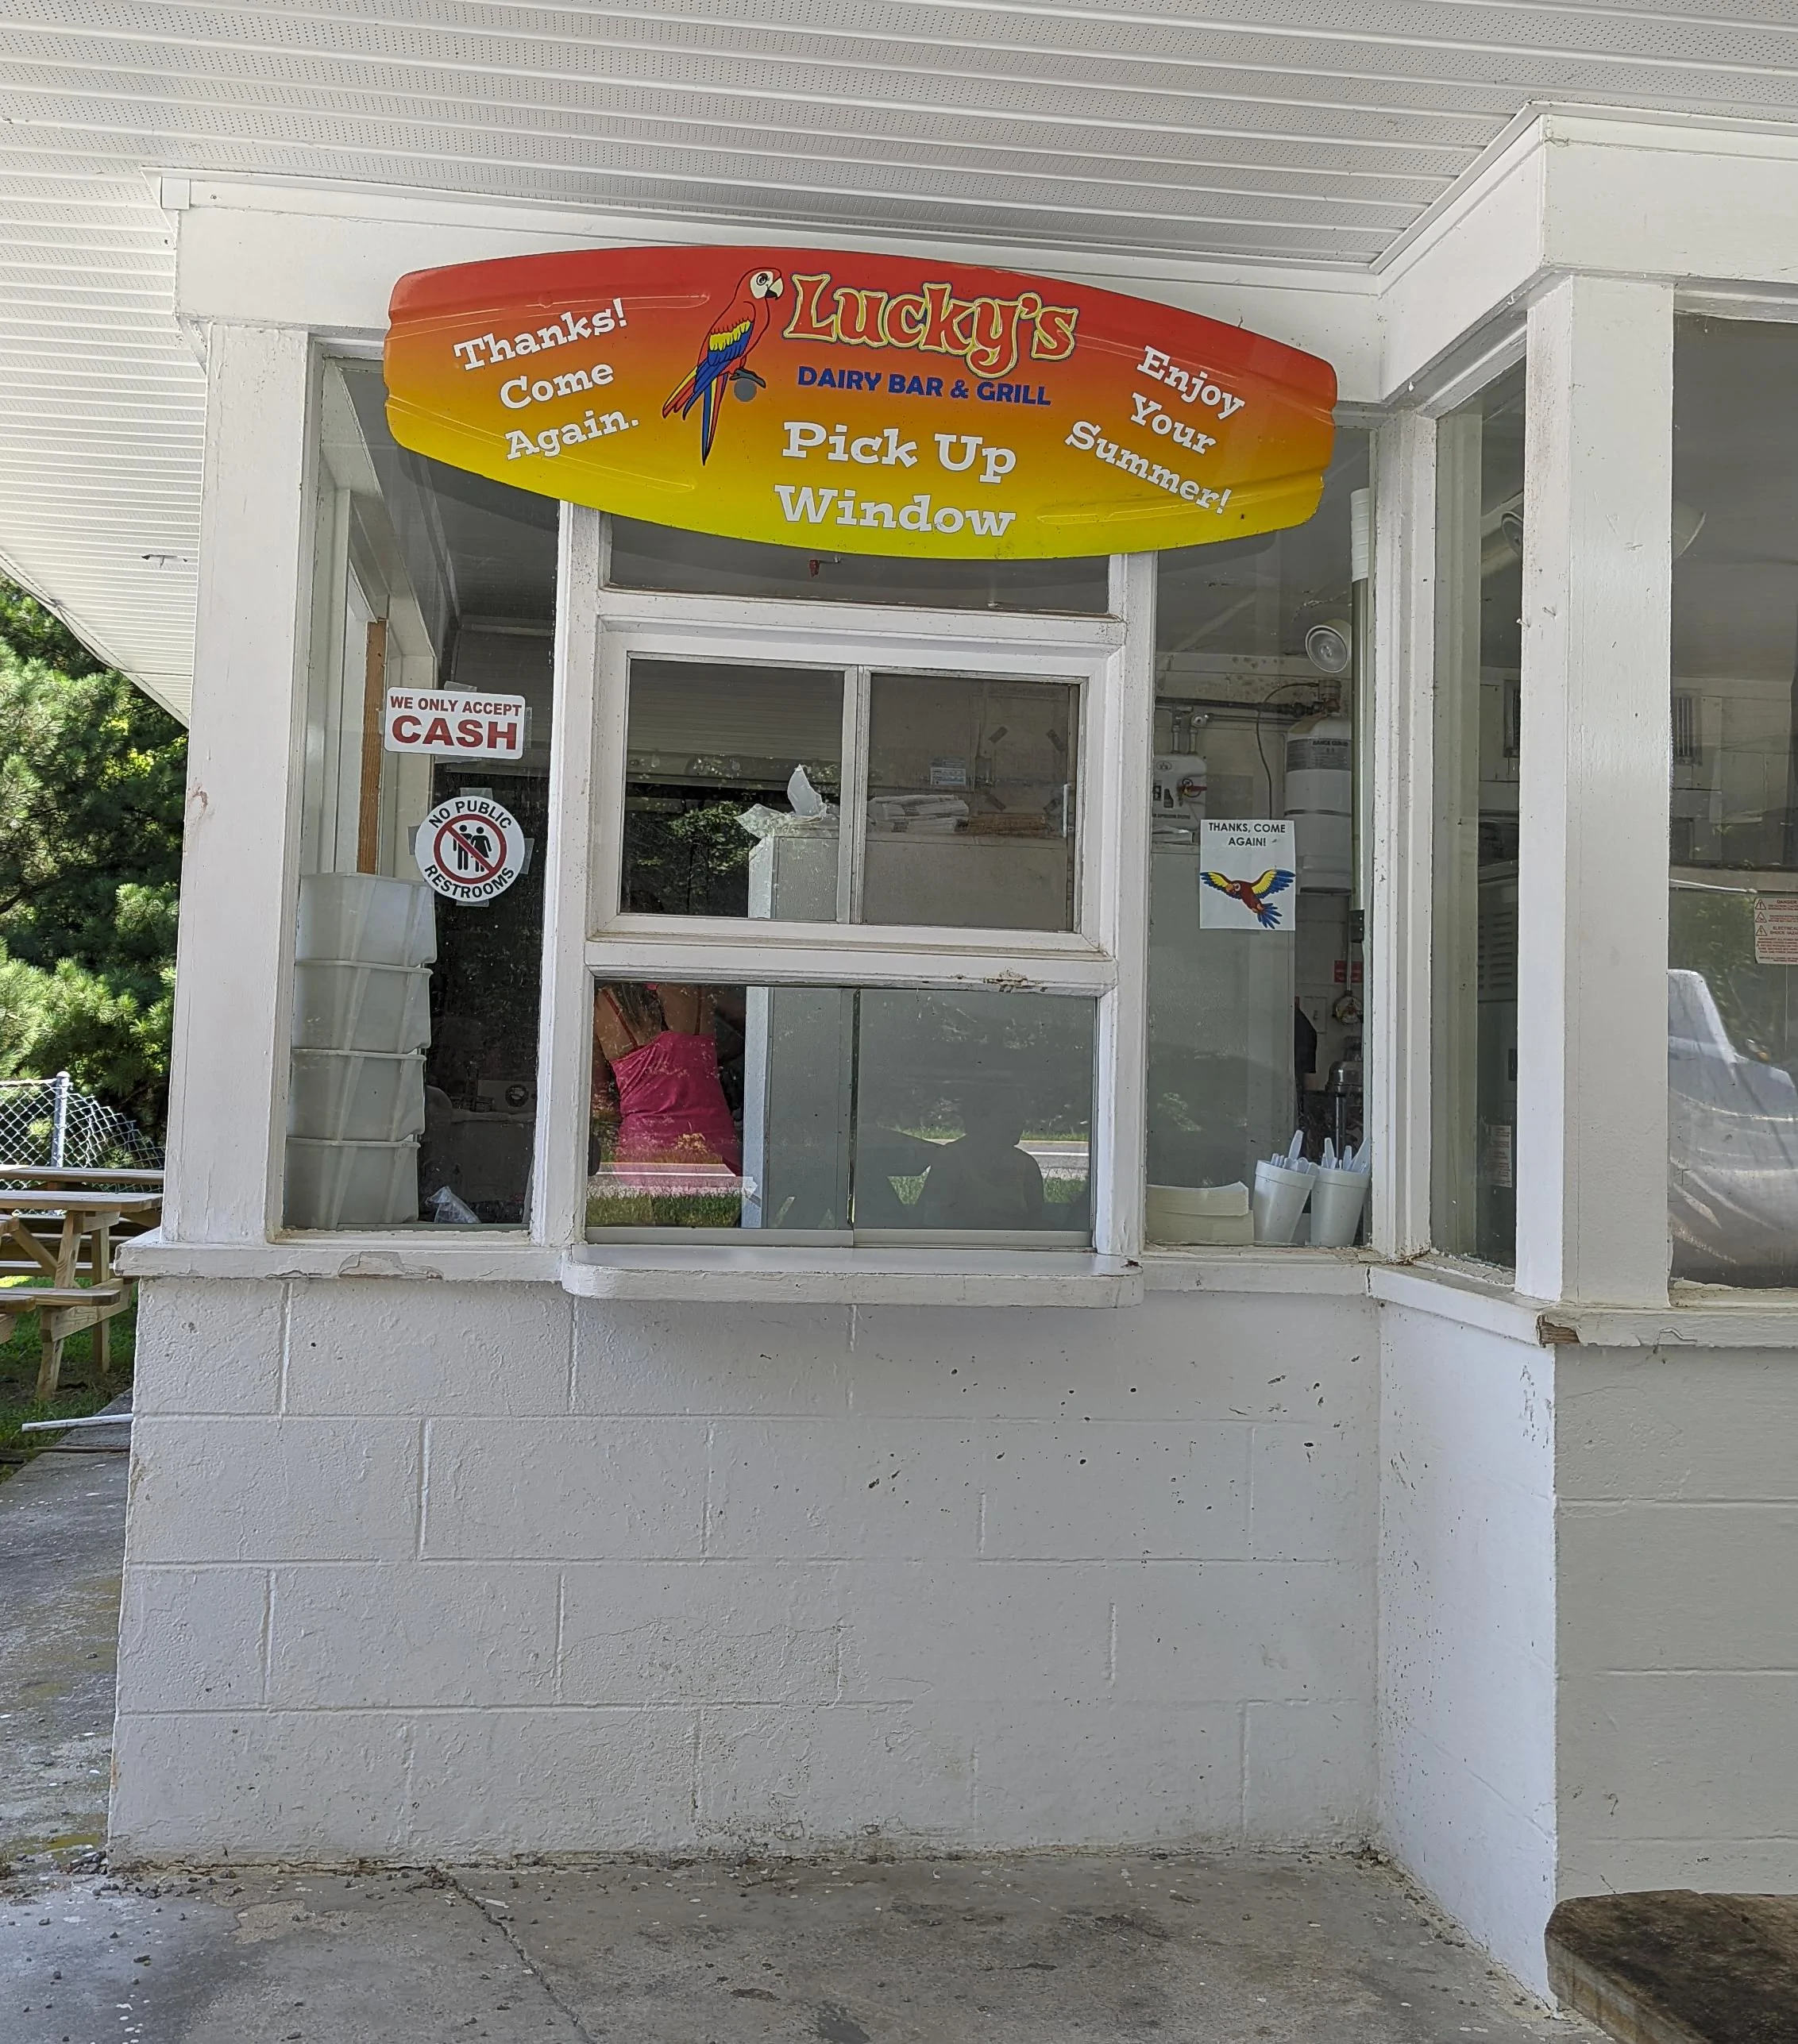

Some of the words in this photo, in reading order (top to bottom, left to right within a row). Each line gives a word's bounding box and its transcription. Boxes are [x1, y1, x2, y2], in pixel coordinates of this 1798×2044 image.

[453, 299, 627, 371] Thanks!
[782, 272, 1080, 379] Lucky's
[500, 364, 614, 410] Come
[797, 366, 882, 391] DAIRY
[888, 373, 943, 397] BAR
[950, 380, 969, 399] &
[977, 381, 1051, 406] GRILL
[1136, 345, 1245, 419] Enjoy
[504, 410, 639, 460] Again.
[1130, 392, 1217, 454] Your
[781, 421, 918, 469] Pick
[934, 433, 1017, 484] Up
[1065, 421, 1232, 515] Summer!
[774, 484, 1017, 537] Window
[390, 696, 413, 709] WE
[418, 697, 458, 712] ONLY
[462, 700, 522, 717] ACCEPT
[392, 715, 517, 750] CASH
[428, 807, 451, 828] NO
[455, 800, 512, 830] PUBLIC
[1209, 822, 1252, 834] THANKS,
[1253, 823, 1286, 833] COME
[1228, 836, 1267, 847] AGAIN!
[424, 863, 515, 899] RESTROOMS
